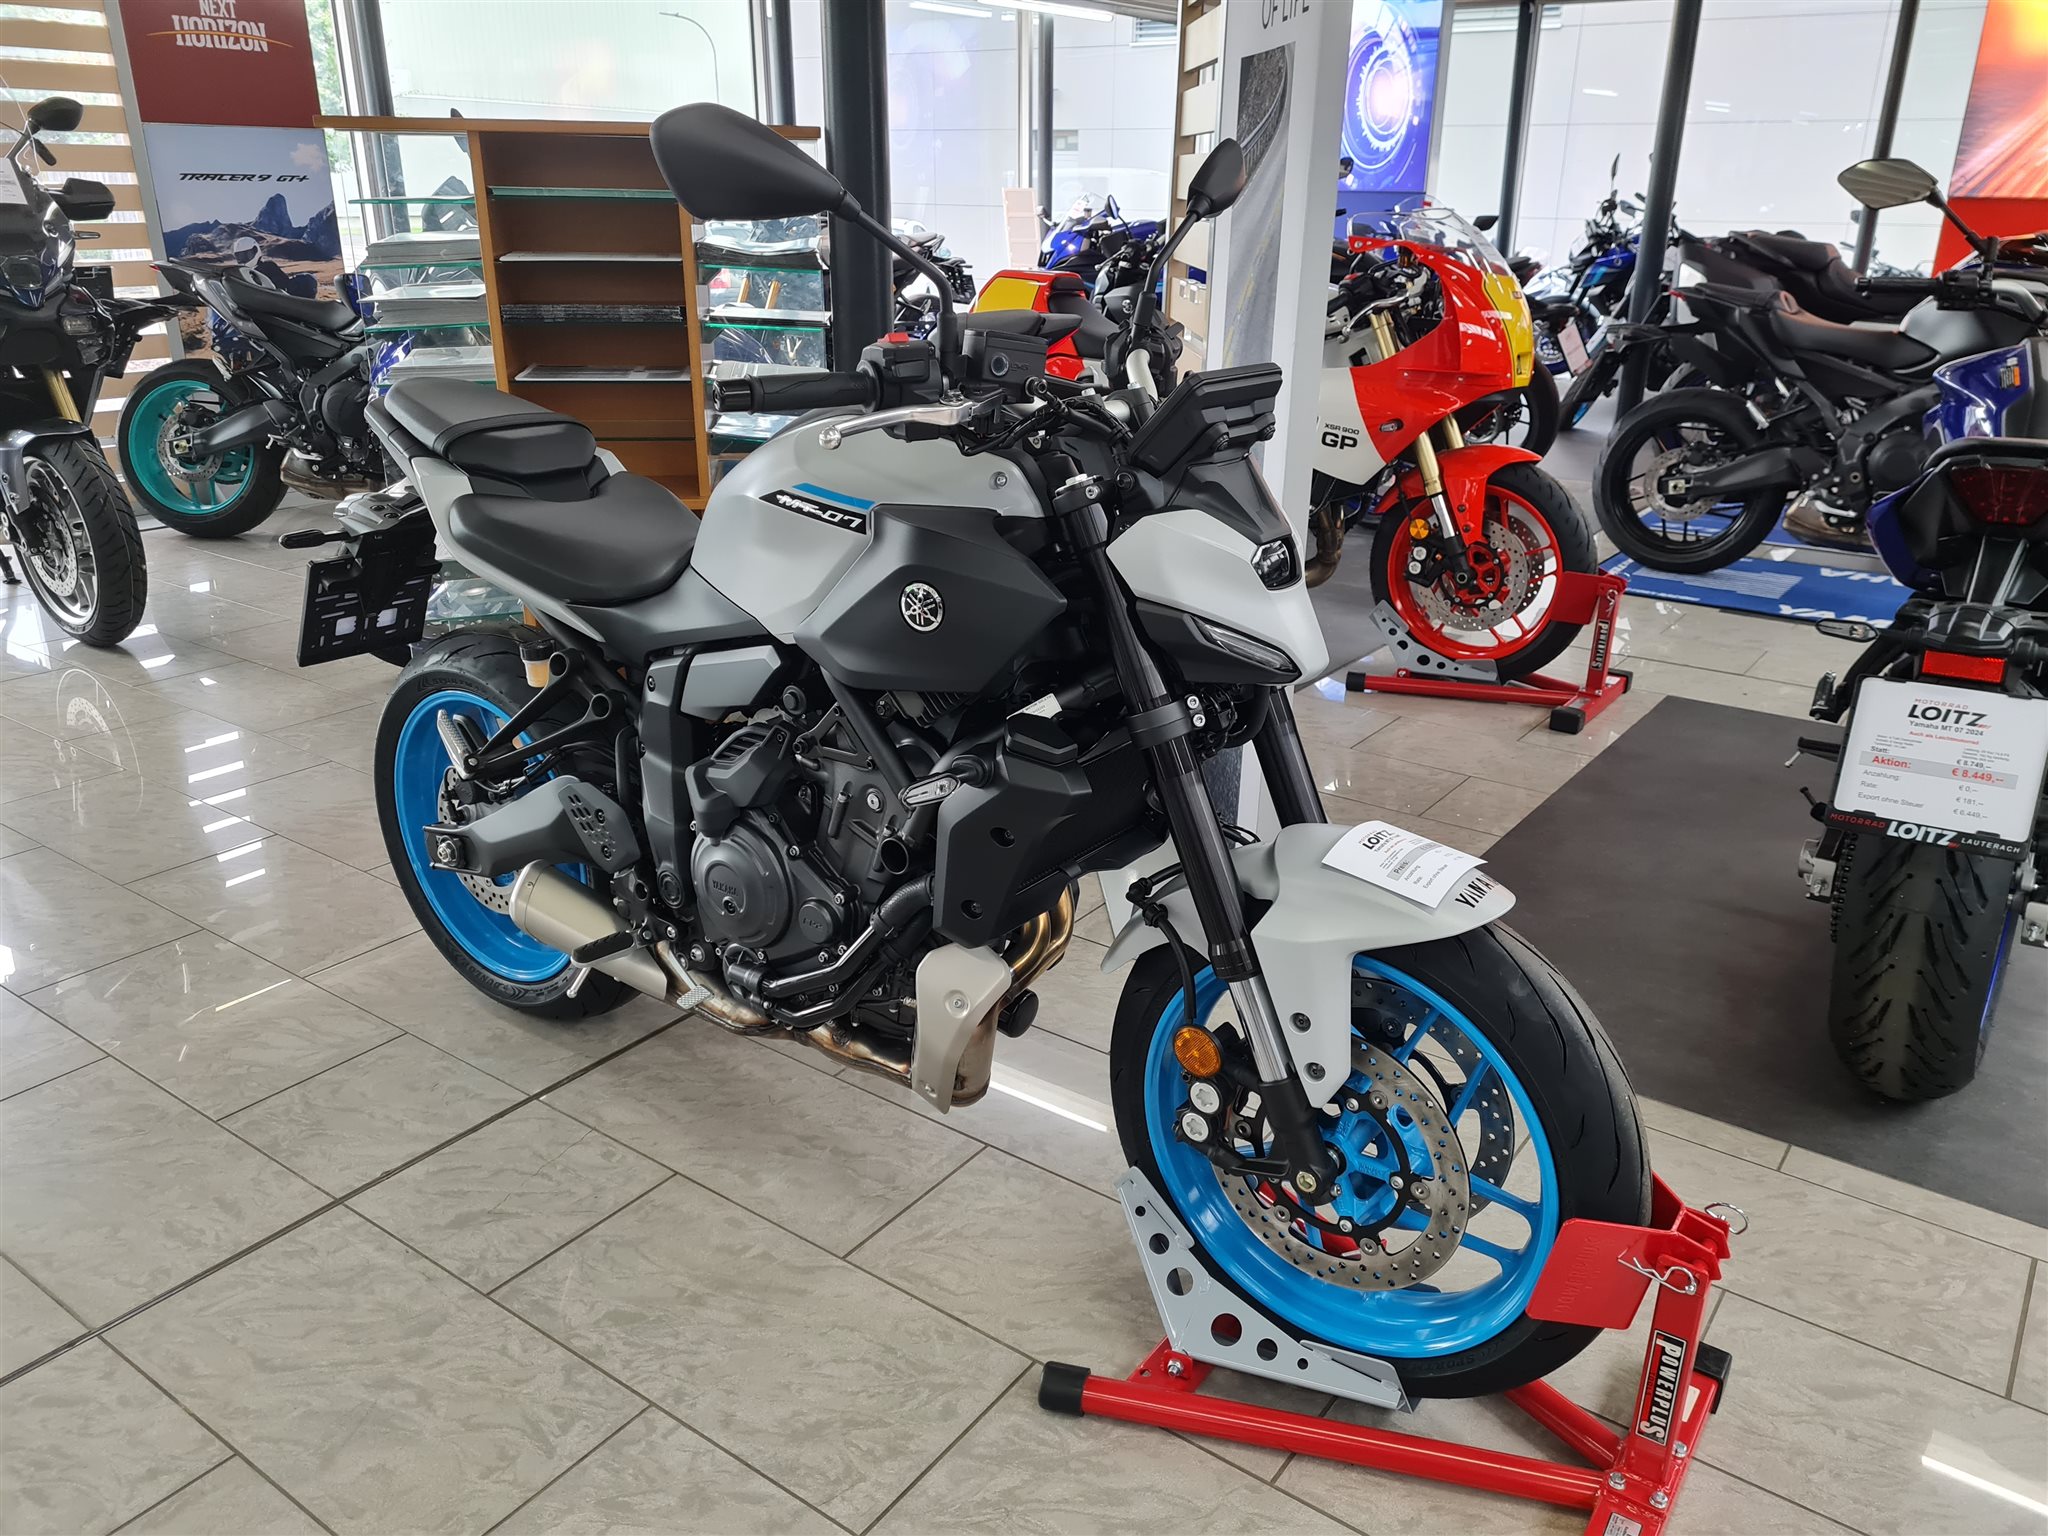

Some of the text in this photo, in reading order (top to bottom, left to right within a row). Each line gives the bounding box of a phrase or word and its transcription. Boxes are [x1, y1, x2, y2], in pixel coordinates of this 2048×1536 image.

[200, 0, 236, 19] NEXT
[171, 14, 269, 53] HORIZON
[179, 172, 257, 182] TRACER
[276, 174, 310, 183] GT+
[1324, 423, 1360, 436] XSR 900
[1321, 431, 1358, 450] GP
[1914, 698, 1969, 710] MOTORRAD
[1907, 704, 1988, 728] LOITZ
[1909, 720, 1939, 731] Yamaha
[1965, 728, 1984, 737] 2024
[1872, 755, 1912, 769] Aktion:
[1952, 768, 1960, 777] €
[1362, 830, 1392, 850] LOITZ
[1830, 812, 2021, 854] MOTORRAD LOITZ LAUTERACH
[1640, 1338, 1682, 1438] POWERPLUS
